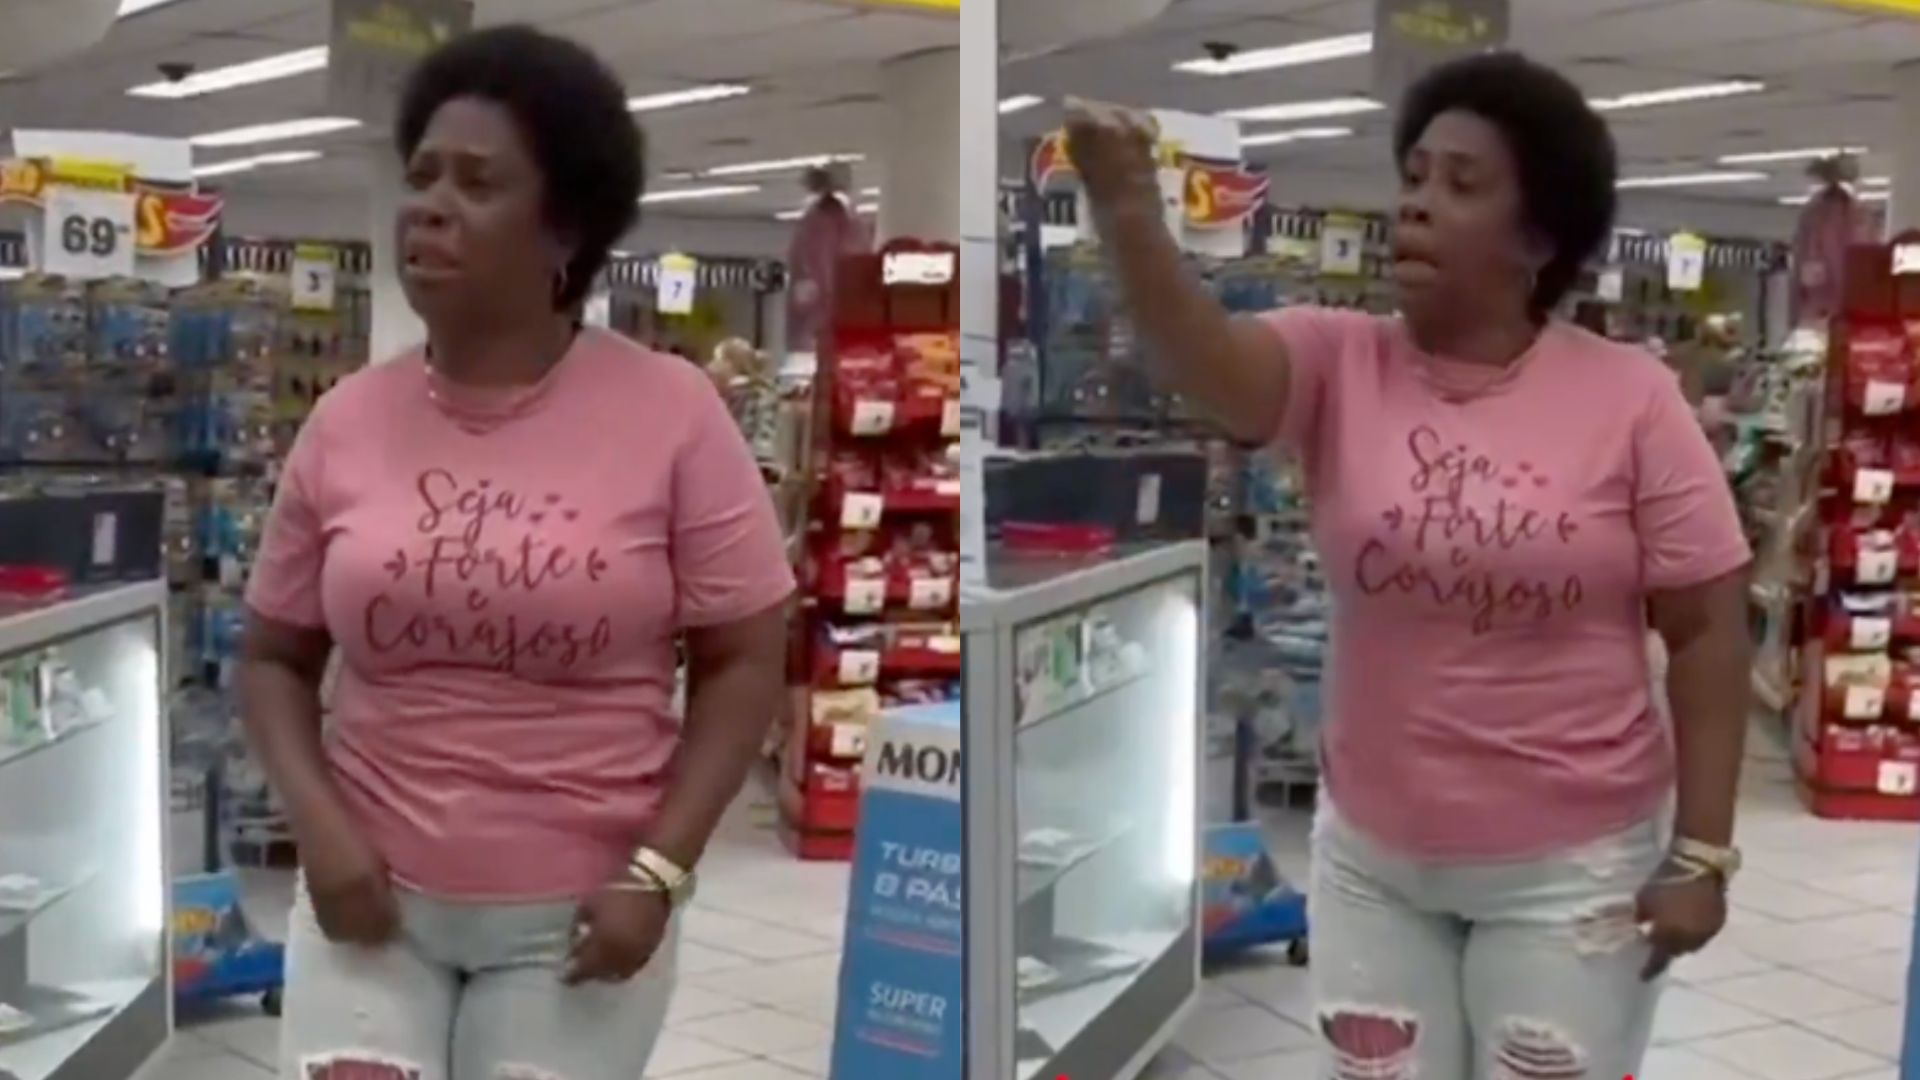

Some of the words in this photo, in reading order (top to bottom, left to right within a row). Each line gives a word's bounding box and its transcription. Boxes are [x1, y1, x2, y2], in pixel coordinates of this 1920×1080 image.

[1408, 425, 1498, 505] Seja
[416, 467, 525, 545] Seja
[1411, 497, 1548, 552] Forte
[416, 535, 575, 597] Forte
[467, 589, 490, 610] e
[1354, 537, 1582, 637] Corajoso
[364, 594, 610, 672] Corajoso
[869, 981, 947, 1020] SUPER
